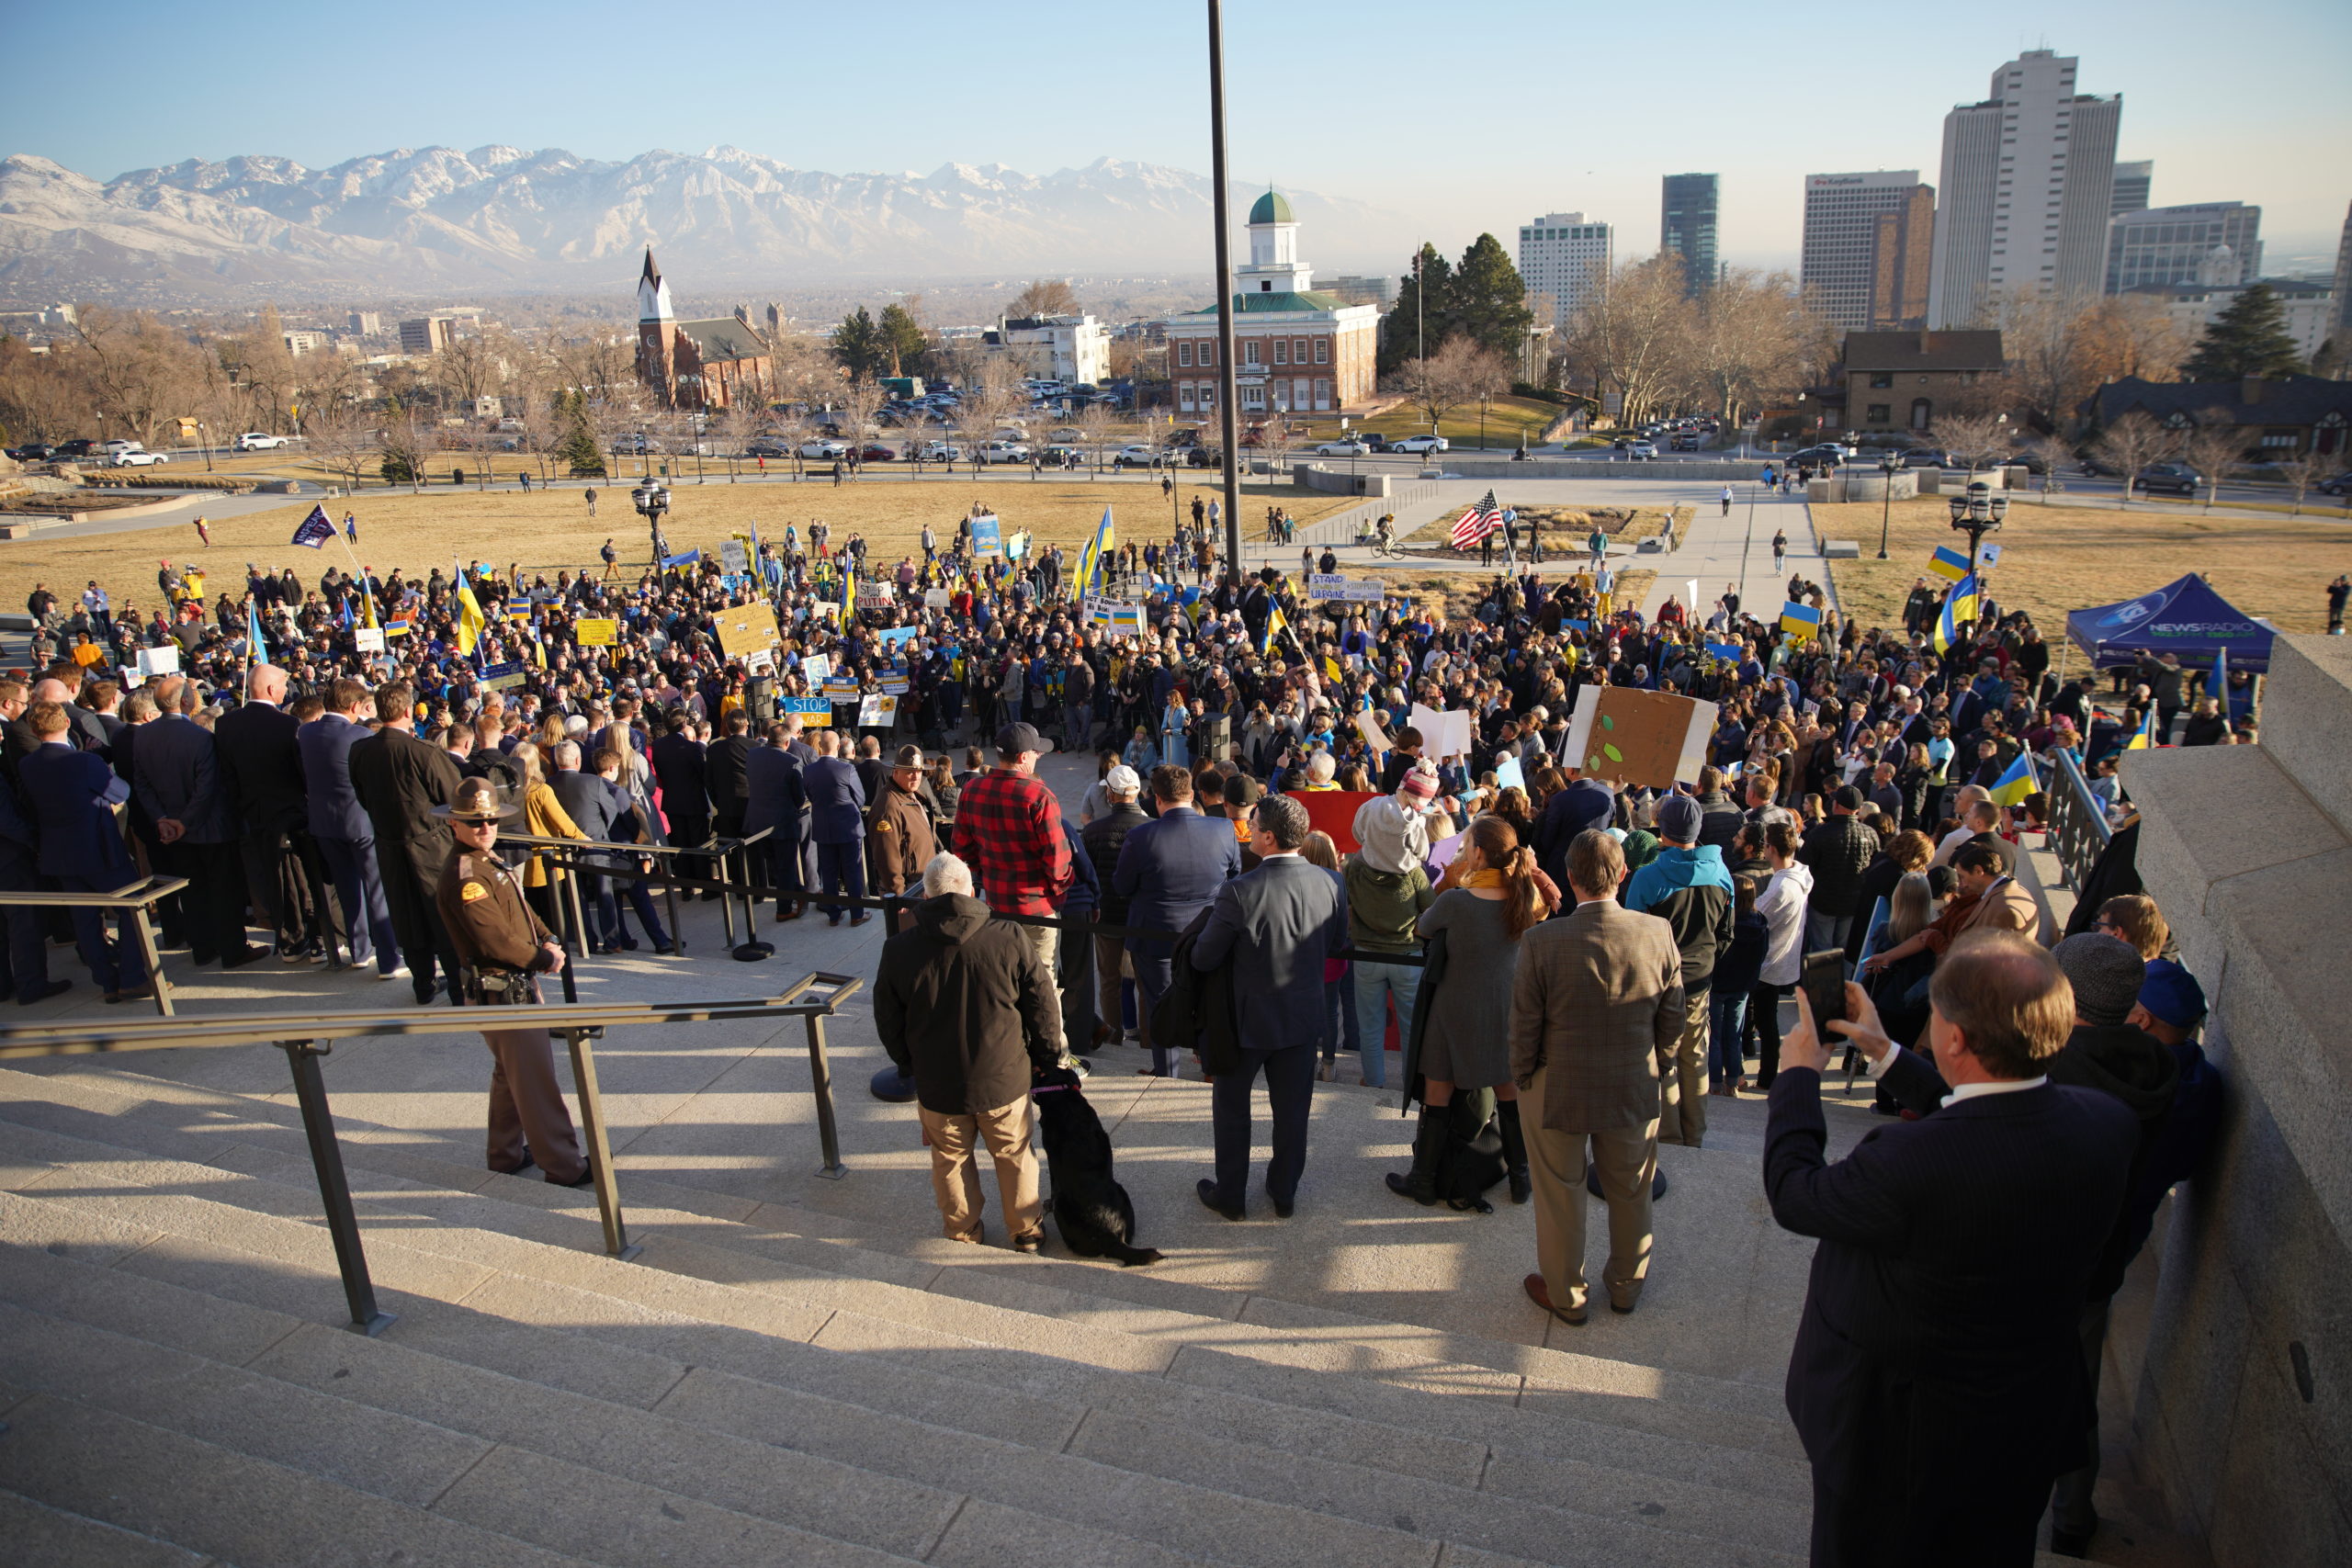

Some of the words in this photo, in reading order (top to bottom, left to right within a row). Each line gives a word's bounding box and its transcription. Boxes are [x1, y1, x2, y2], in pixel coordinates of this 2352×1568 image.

[1828, 176, 1864, 187] KeyBank
[1314, 575, 1343, 583] STAND
[1311, 590, 1345, 599] UKRAINE
[858, 596, 892, 607] PUTIN
[2150, 623, 2256, 632] NEWSRADIO
[793, 698, 828, 712] STOP
